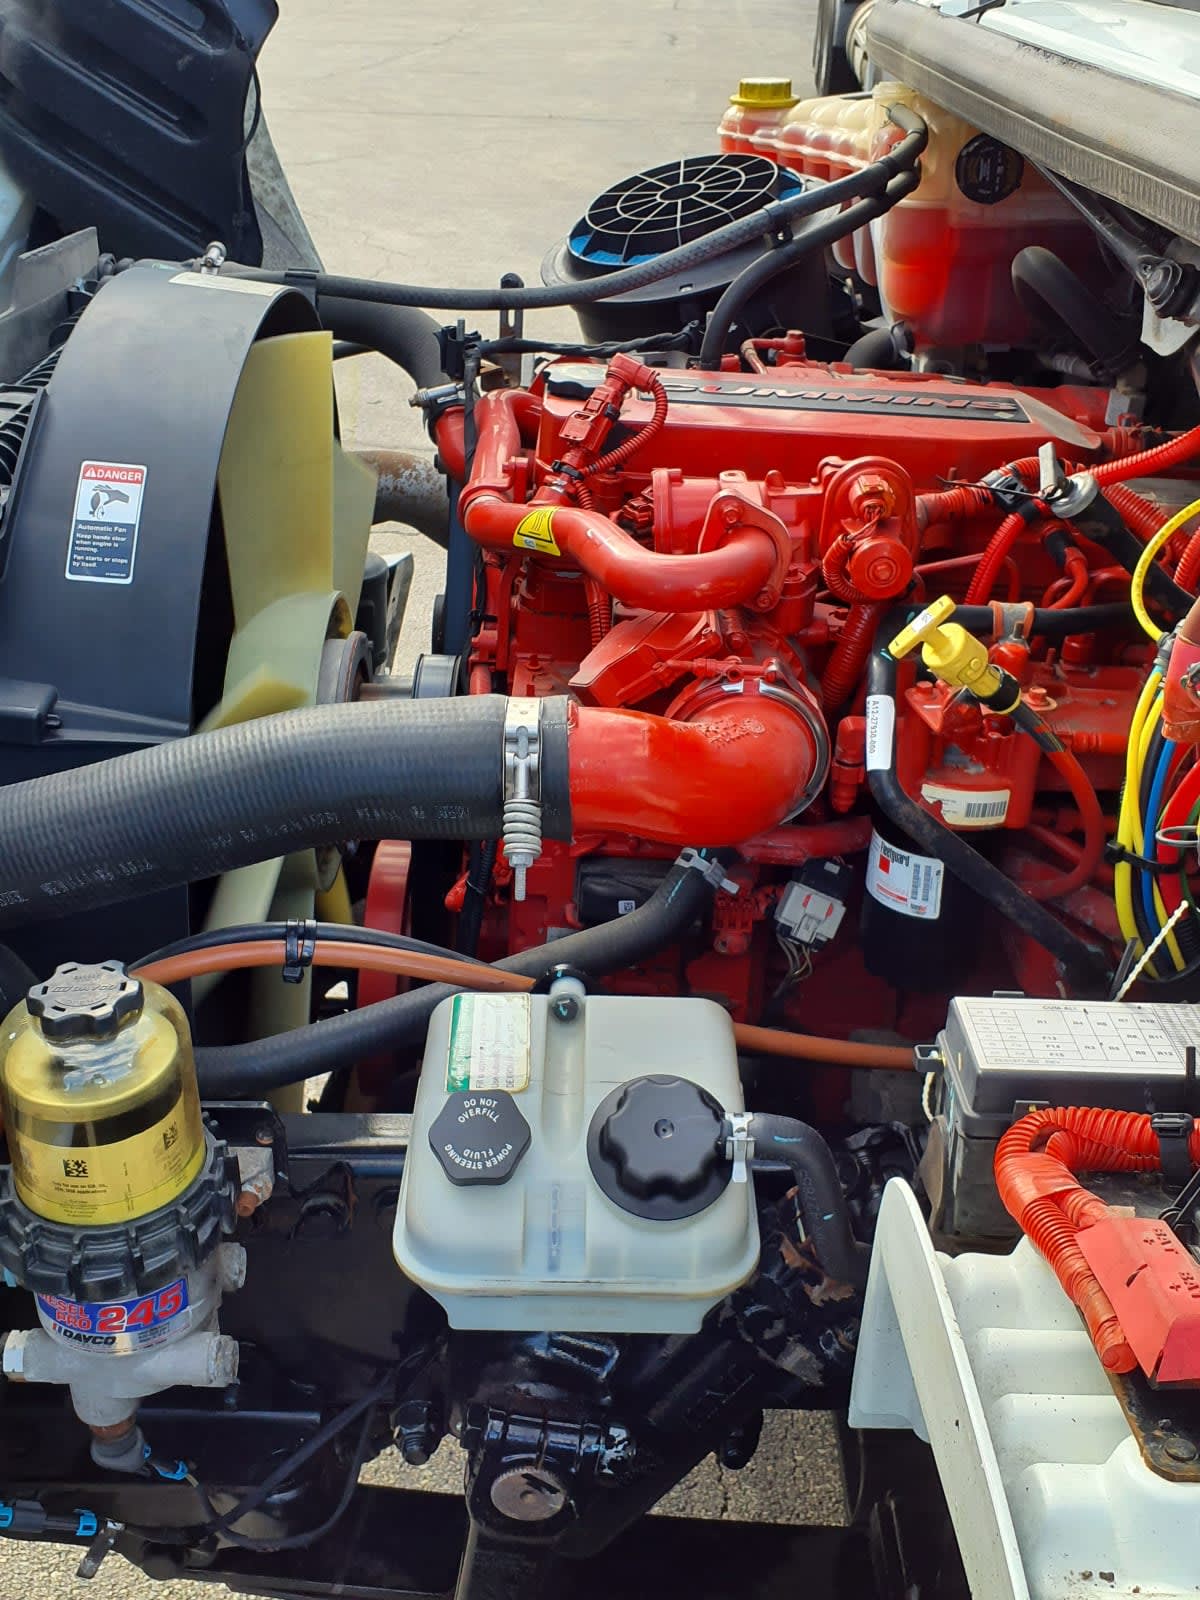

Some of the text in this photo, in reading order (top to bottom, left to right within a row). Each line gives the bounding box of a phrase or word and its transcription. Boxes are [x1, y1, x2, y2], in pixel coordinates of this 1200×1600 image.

[97, 469, 142, 481] DANGER
[78, 524, 112, 532] Automatic
[463, 1097, 499, 1109] DO NOT
[457, 1107, 500, 1124] OVERFILL
[444, 1143, 513, 1170] POWER STEERING
[463, 1147, 494, 1160] FLUID
[96, 1281, 184, 1333] 245
[56, 1310, 92, 1330] PRO
[62, 1328, 117, 1346] DAYCO
